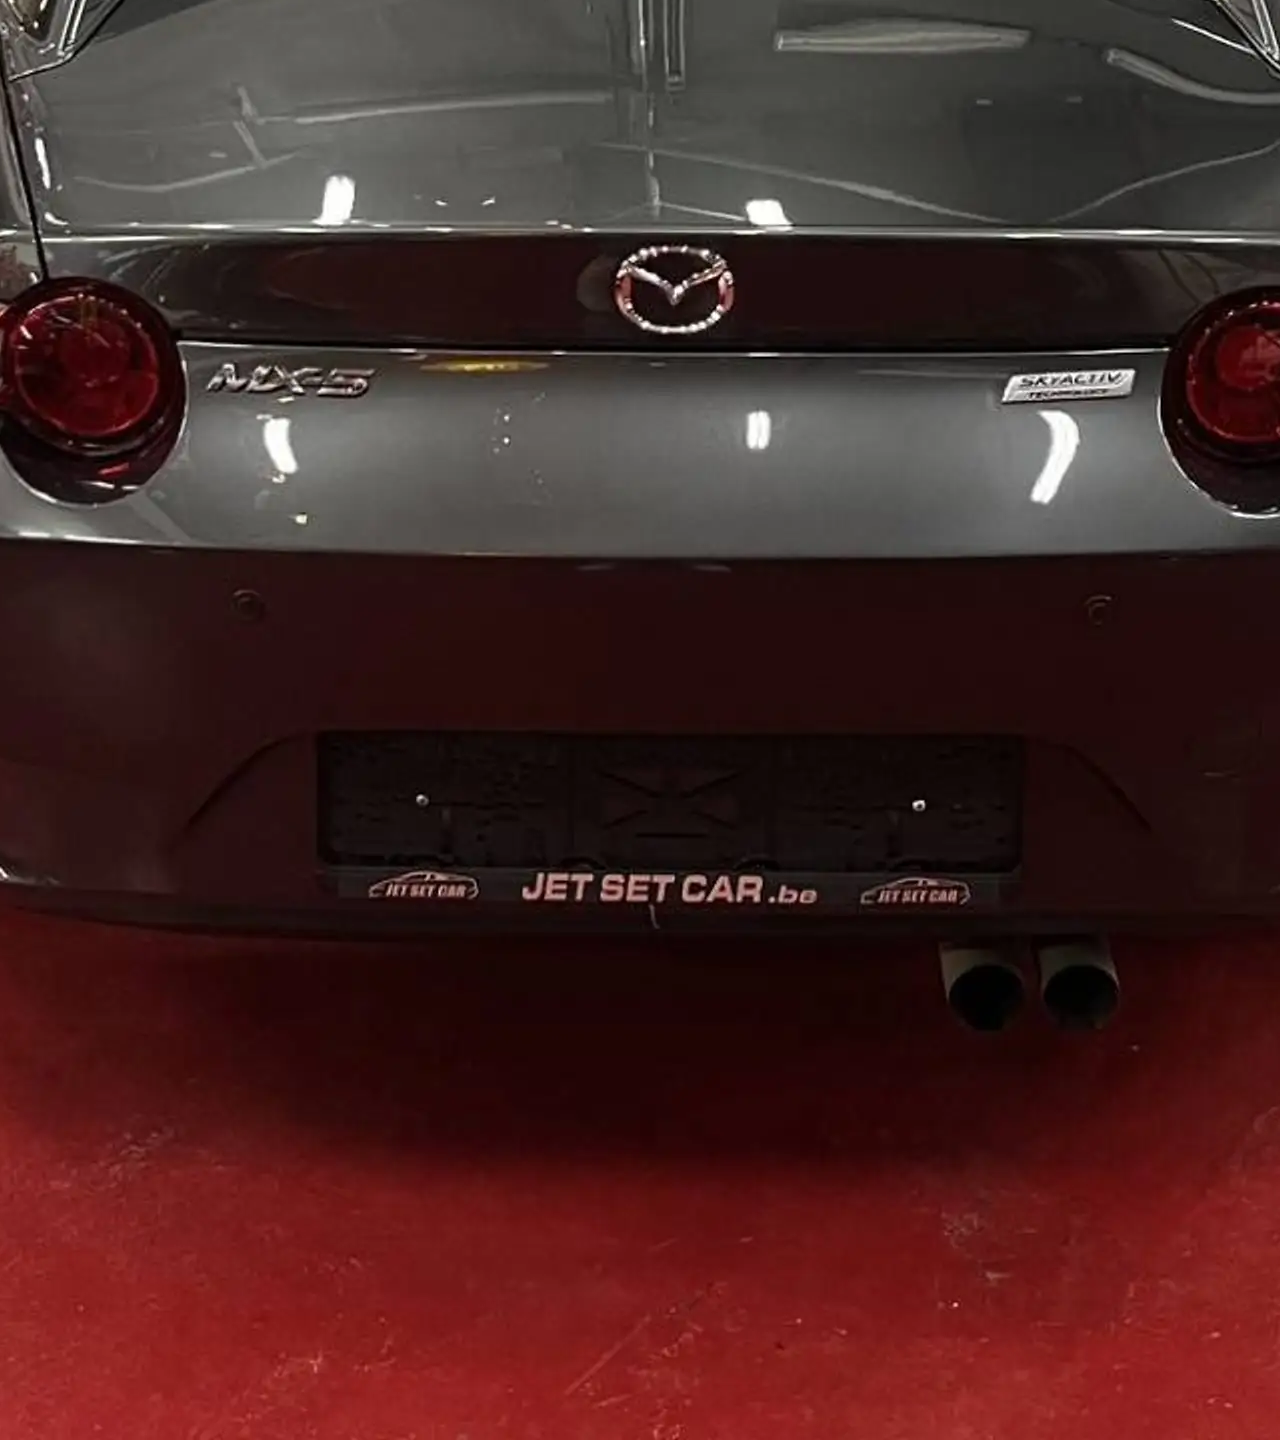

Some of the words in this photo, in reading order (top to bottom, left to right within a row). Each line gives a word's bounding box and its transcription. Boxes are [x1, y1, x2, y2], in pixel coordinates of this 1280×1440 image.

[1020, 371, 1122, 388] SKYACTIV
[521, 872, 595, 901] JET
[600, 873, 676, 903] SET
